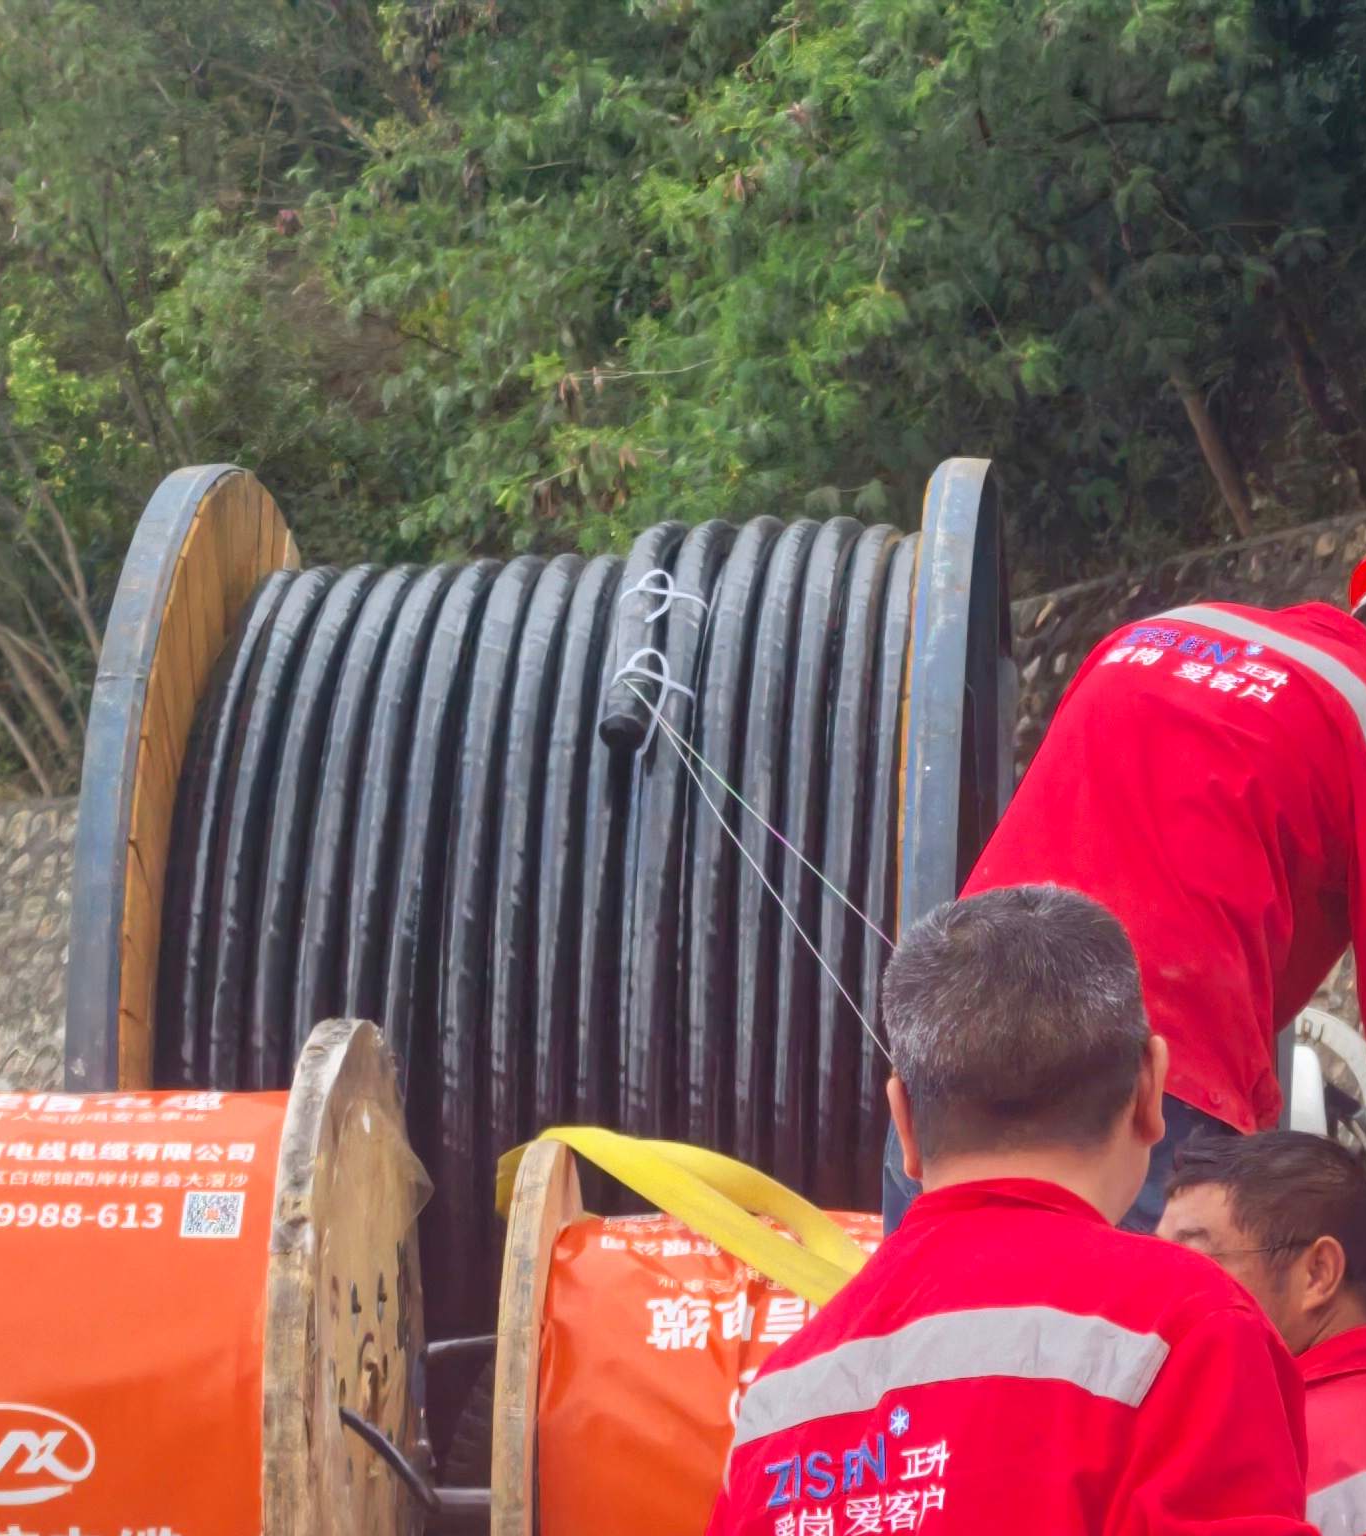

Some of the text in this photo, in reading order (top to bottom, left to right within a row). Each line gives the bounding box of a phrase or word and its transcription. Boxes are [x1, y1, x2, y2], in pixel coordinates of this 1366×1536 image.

[1172, 661, 1275, 703] 爱客户
[1237, 661, 1288, 688] 正升
[900, 1440, 951, 1481] 正升
